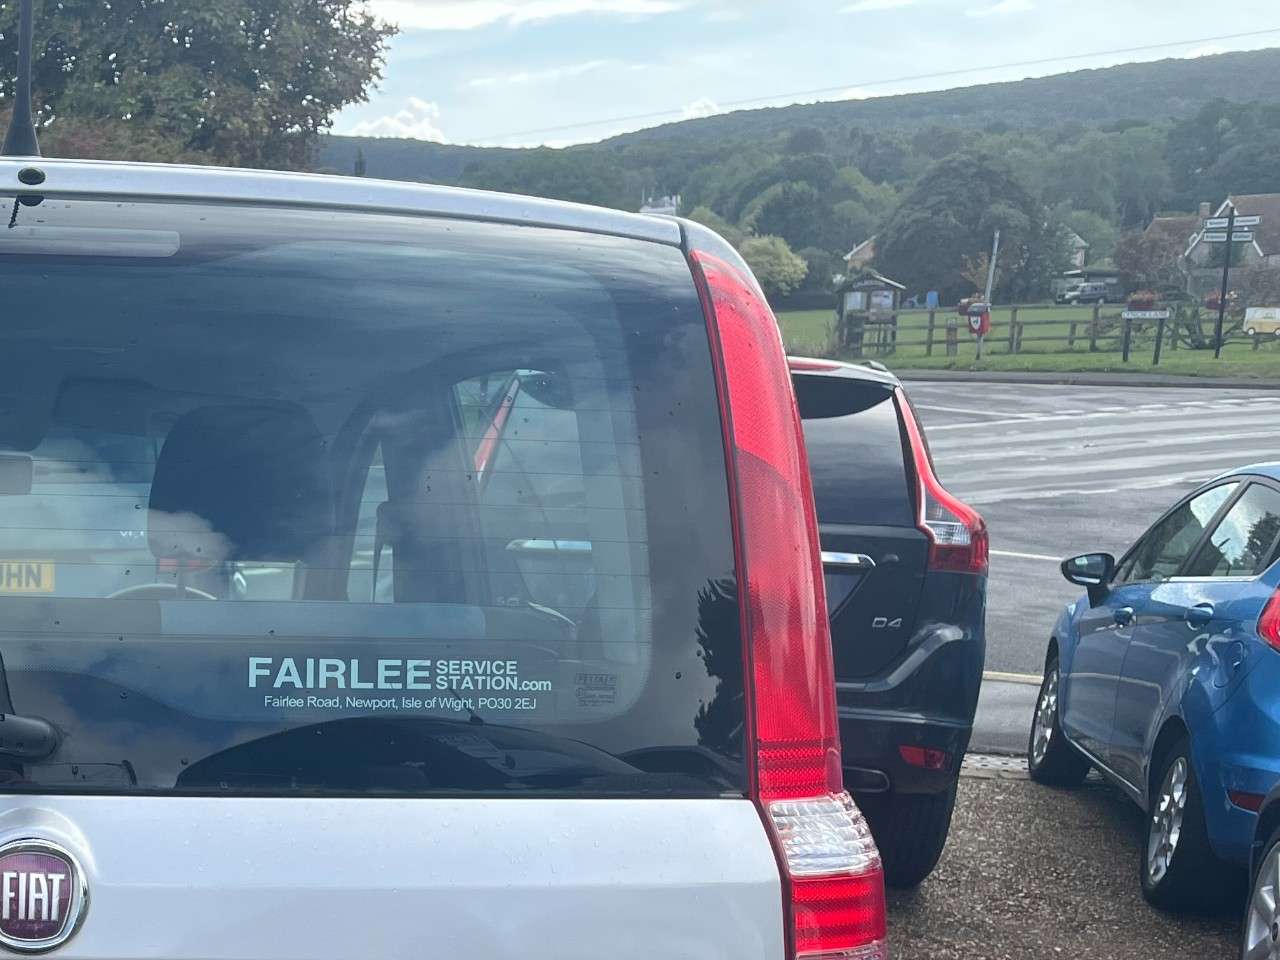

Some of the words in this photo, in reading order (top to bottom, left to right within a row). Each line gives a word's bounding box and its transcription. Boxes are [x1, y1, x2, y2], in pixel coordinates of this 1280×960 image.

[871, 617, 902, 628] D4
[248, 657, 432, 690] FAIRLEE
[436, 660, 517, 675] SERVICE
[264, 696, 304, 708] Fairlee
[307, 697, 342, 710] Road,
[346, 698, 399, 712] Newport,
[402, 698, 421, 709] Isle
[424, 698, 436, 709] of
[438, 698, 475, 713] Wight,
[478, 699, 512, 710] PO30
[514, 699, 537, 710] 2EJ
[2, 871, 65, 920] FIAT
